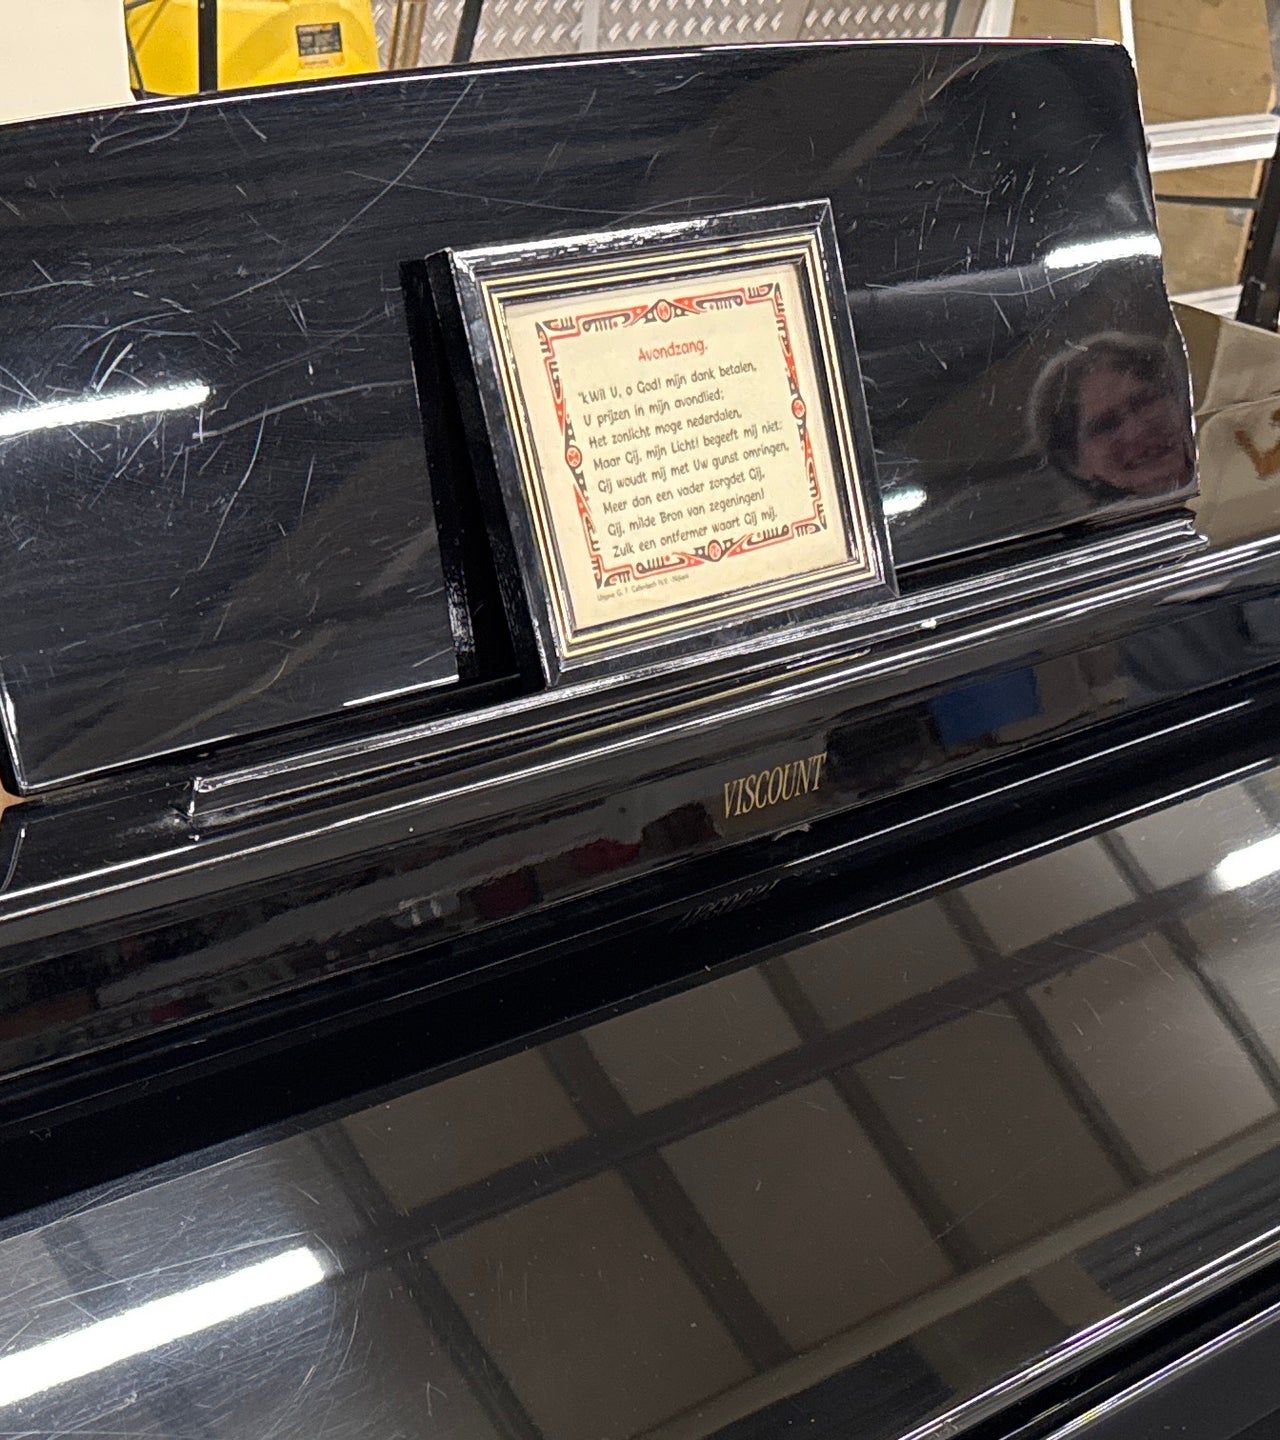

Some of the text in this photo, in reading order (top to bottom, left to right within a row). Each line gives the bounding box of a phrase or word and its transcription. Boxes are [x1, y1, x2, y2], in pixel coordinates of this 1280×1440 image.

[639, 340, 708, 361] Avondzang.
[626, 386, 633, 396] o
[637, 380, 662, 394] God!
[666, 374, 687, 389] mijn
[691, 369, 715, 382] dank
[584, 415, 591, 427] U
[597, 408, 631, 427] prijzen
[634, 404, 644, 416] in
[649, 400, 670, 417] mijn
[589, 437, 607, 449] Het
[611, 425, 651, 445] zonlicht
[655, 421, 681, 435] moge
[593, 457, 620, 471] Maar
[646, 445, 667, 460] mijn
[671, 437, 699, 454] Licht!
[703, 429, 739, 448] begeeft
[744, 424, 758, 439] mij
[598, 478, 612, 494] Gij
[616, 472, 648, 489] woudt
[652, 468, 667, 482] mij
[671, 462, 690, 477] met
[693, 459, 708, 471] Uw
[712, 452, 739, 470] gunst
[603, 500, 627, 515] Meer
[632, 494, 653, 509] dan
[656, 489, 674, 503] een
[677, 483, 705, 496] vader
[709, 472, 745, 490] zorgdet
[629, 516, 657, 532] milde
[659, 511, 683, 524] Bron
[687, 504, 706, 518] van
[709, 488, 765, 512] zegeningen!
[612, 543, 635, 558] Zulk
[638, 539, 657, 552] een
[660, 526, 708, 546] ontfermer
[712, 516, 740, 533] waart
[744, 512, 757, 526] Gij
[724, 752, 827, 818] VISCOUNT
